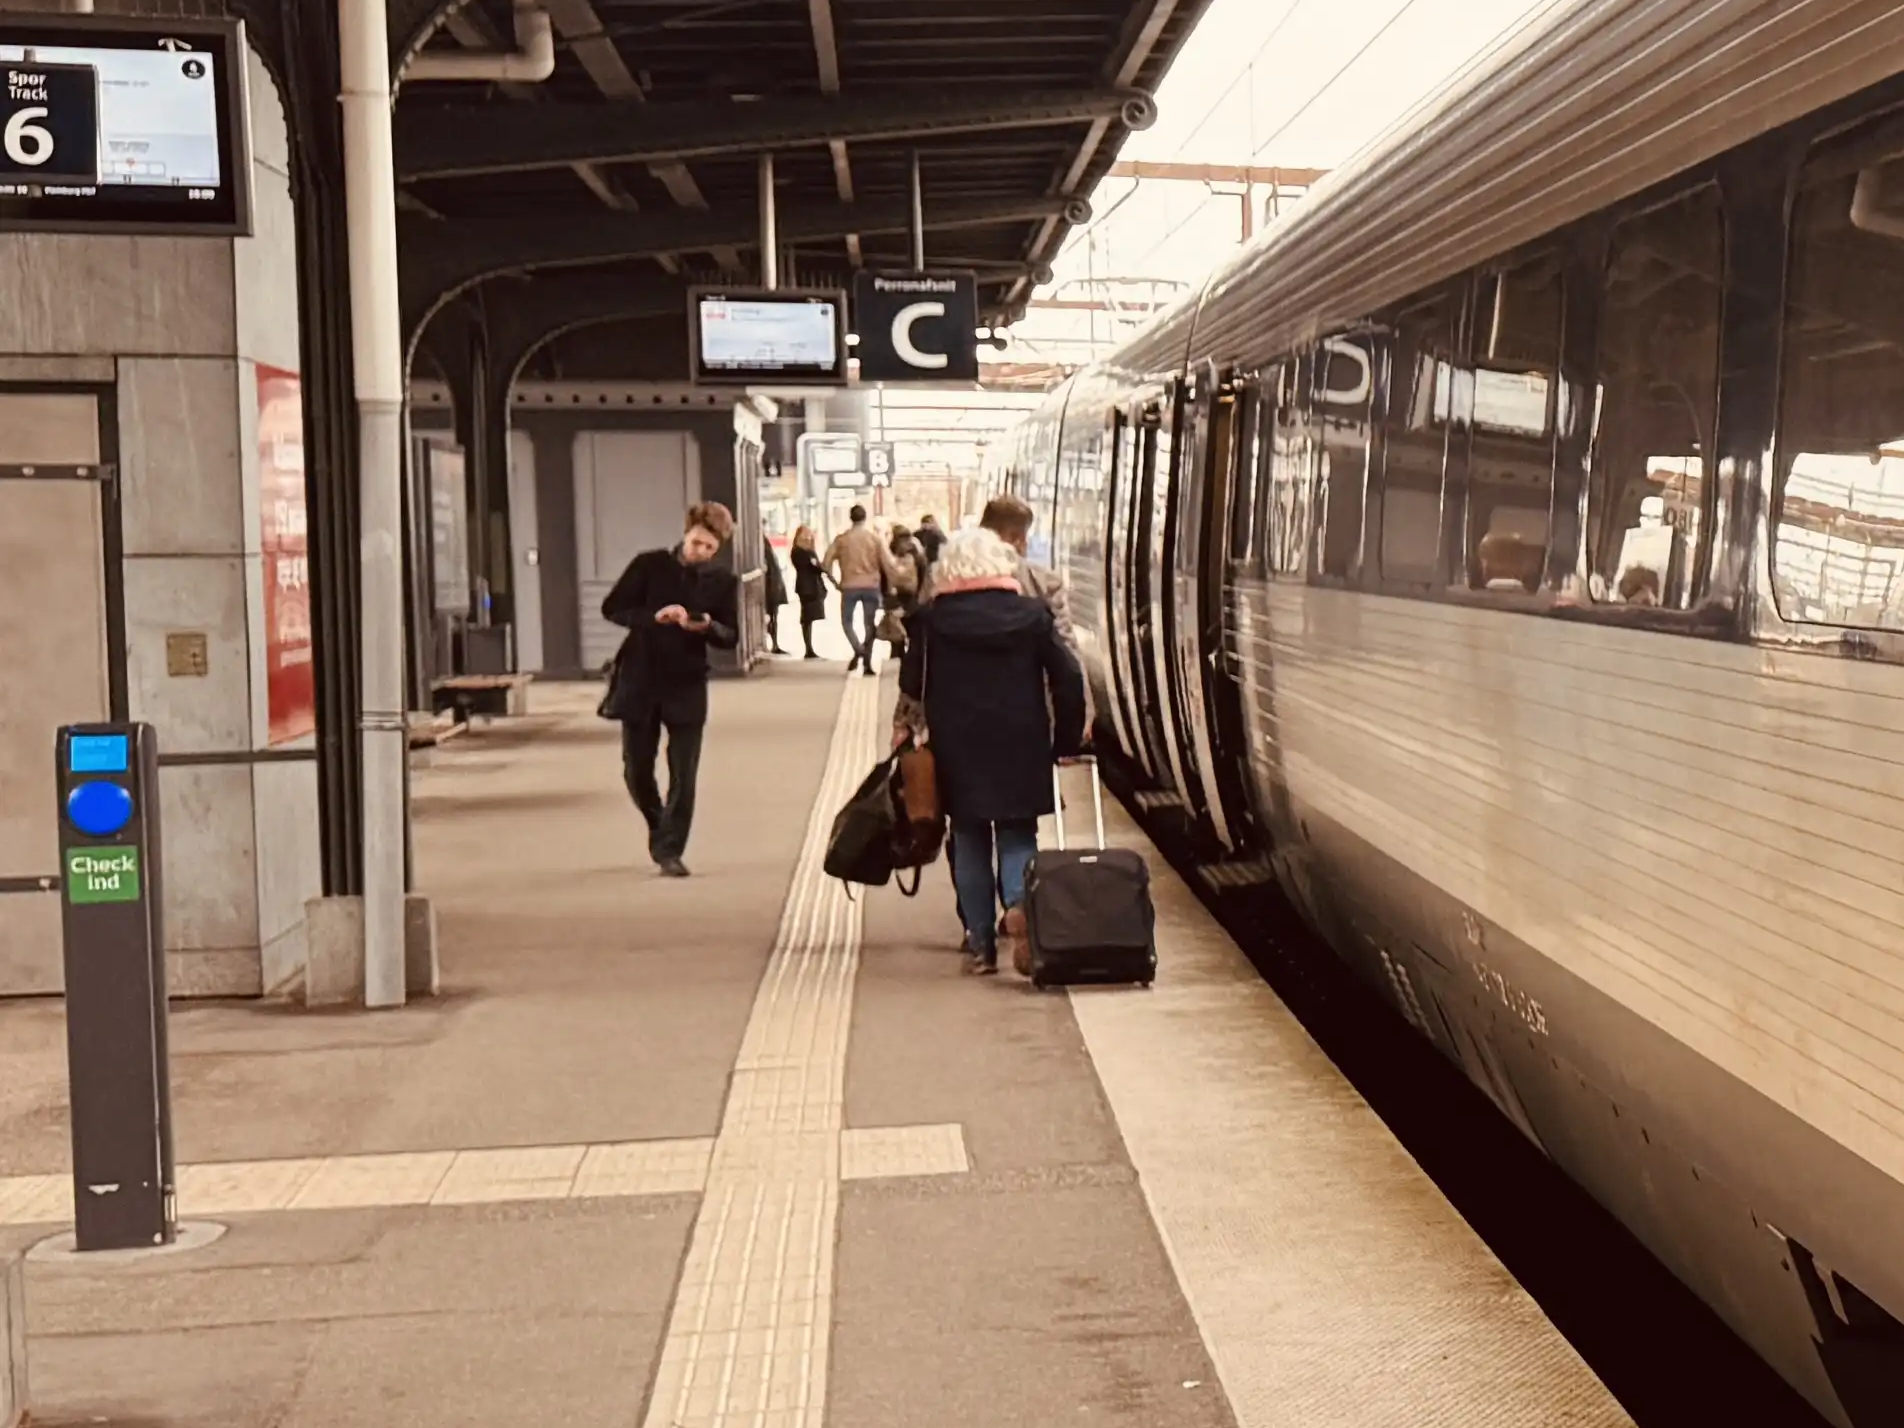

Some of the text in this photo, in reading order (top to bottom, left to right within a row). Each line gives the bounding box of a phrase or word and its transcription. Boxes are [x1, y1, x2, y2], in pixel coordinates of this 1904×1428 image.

[8, 70, 47, 87] Spor
[8, 85, 48, 101] Track
[4, 106, 54, 166] 6
[874, 277, 956, 293] Perronafsnit
[891, 302, 948, 369] C
[71, 855, 135, 873] Check
